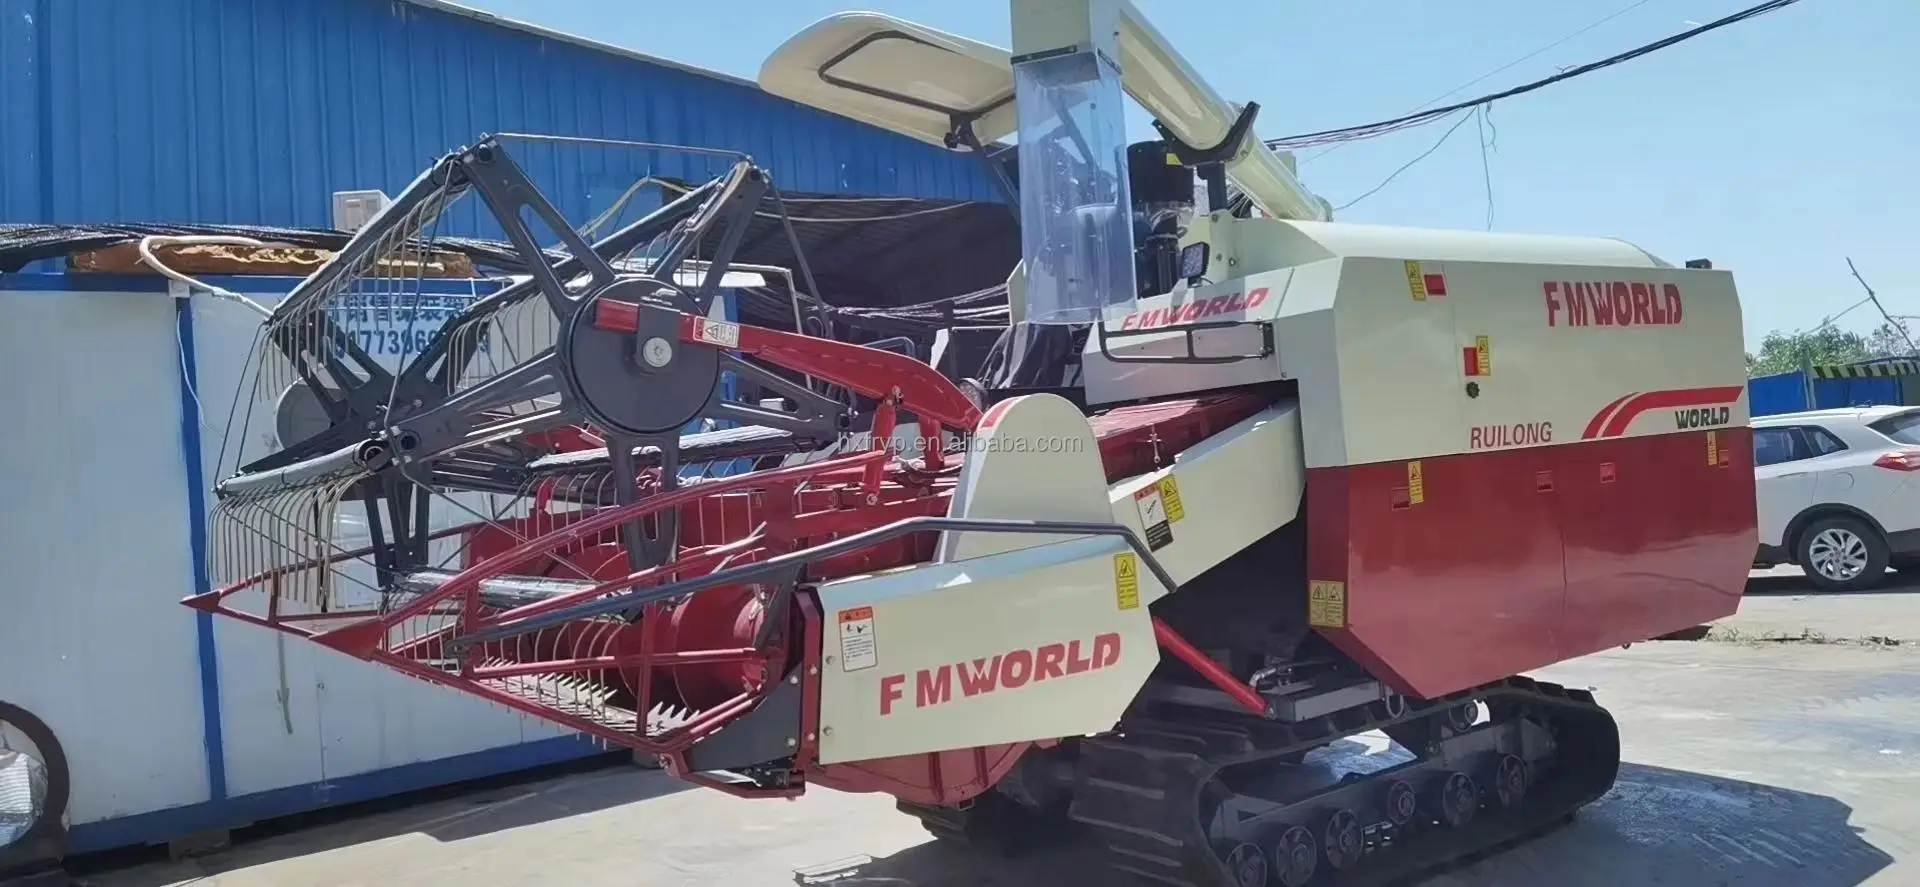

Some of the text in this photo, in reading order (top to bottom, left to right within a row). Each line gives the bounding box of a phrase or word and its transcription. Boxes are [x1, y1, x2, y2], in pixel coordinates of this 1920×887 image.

[1543, 281, 1683, 327] FMWORLD
[1470, 421, 1552, 449] RUILONG
[1675, 406, 1730, 429] WORLD
[880, 632, 1121, 716] FMWORLD
